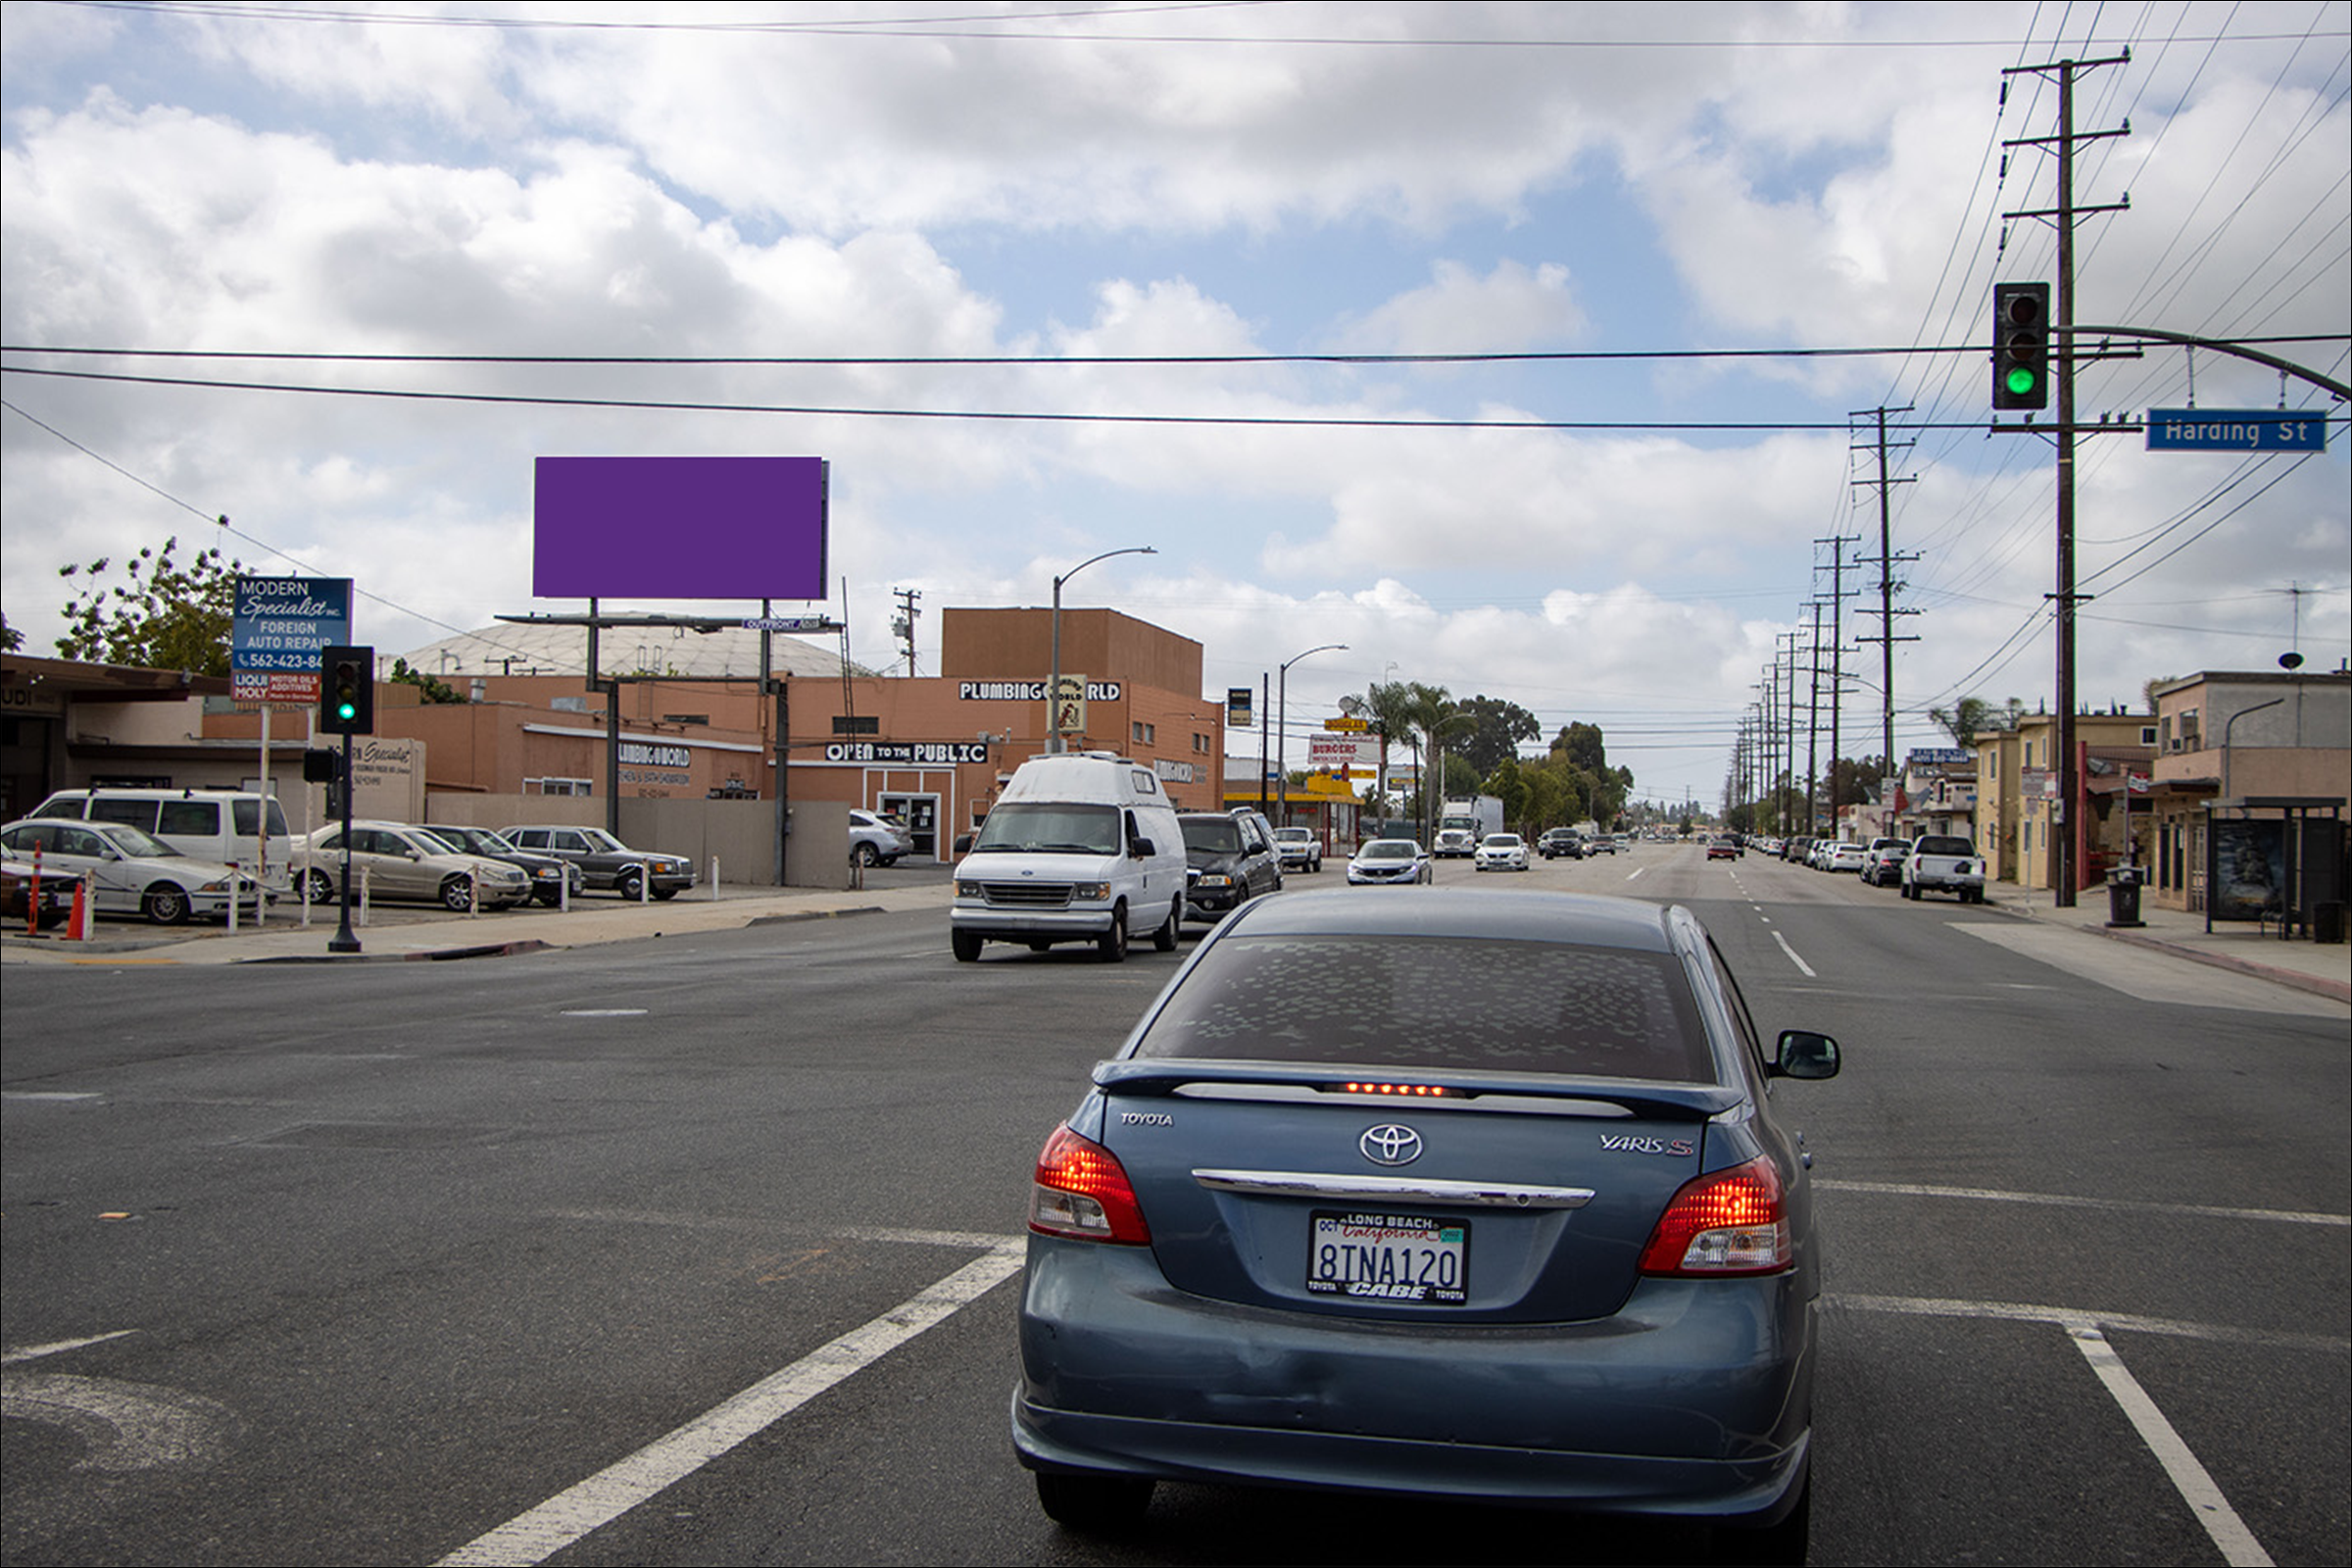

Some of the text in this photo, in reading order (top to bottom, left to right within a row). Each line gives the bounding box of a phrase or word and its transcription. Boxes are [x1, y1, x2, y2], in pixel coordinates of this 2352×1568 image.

[2166, 419, 2308, 448] Harding St
[241, 581, 309, 596] MODERN
[241, 596, 326, 623] Specialist
[260, 621, 317, 634] FOREIGN
[247, 637, 333, 650] AUTO REPAIR
[250, 654, 323, 667] 562-423-84
[270, 675, 318, 685] MOTOR OILS
[270, 683, 313, 692] ADDITIVES
[236, 687, 269, 699] MOLY
[959, 683, 1120, 701] PLUMBING RLD
[619, 743, 654, 763] LUMBING
[826, 743, 986, 762] OPEN TO THE PUBLIC
[1312, 744, 1357, 754] BURGERS
[1121, 1112, 1174, 1126] TOYOTA
[1599, 1134, 1694, 1156] YARIS S
[1348, 1214, 1433, 1230] LONG BEACH
[1342, 1225, 1440, 1245] California
[1320, 1244, 1456, 1287] 8TNA120
[1308, 1281, 1337, 1292] TOYOTA
[1347, 1281, 1429, 1299] CABE
[1436, 1290, 1465, 1300] TOYOTA
